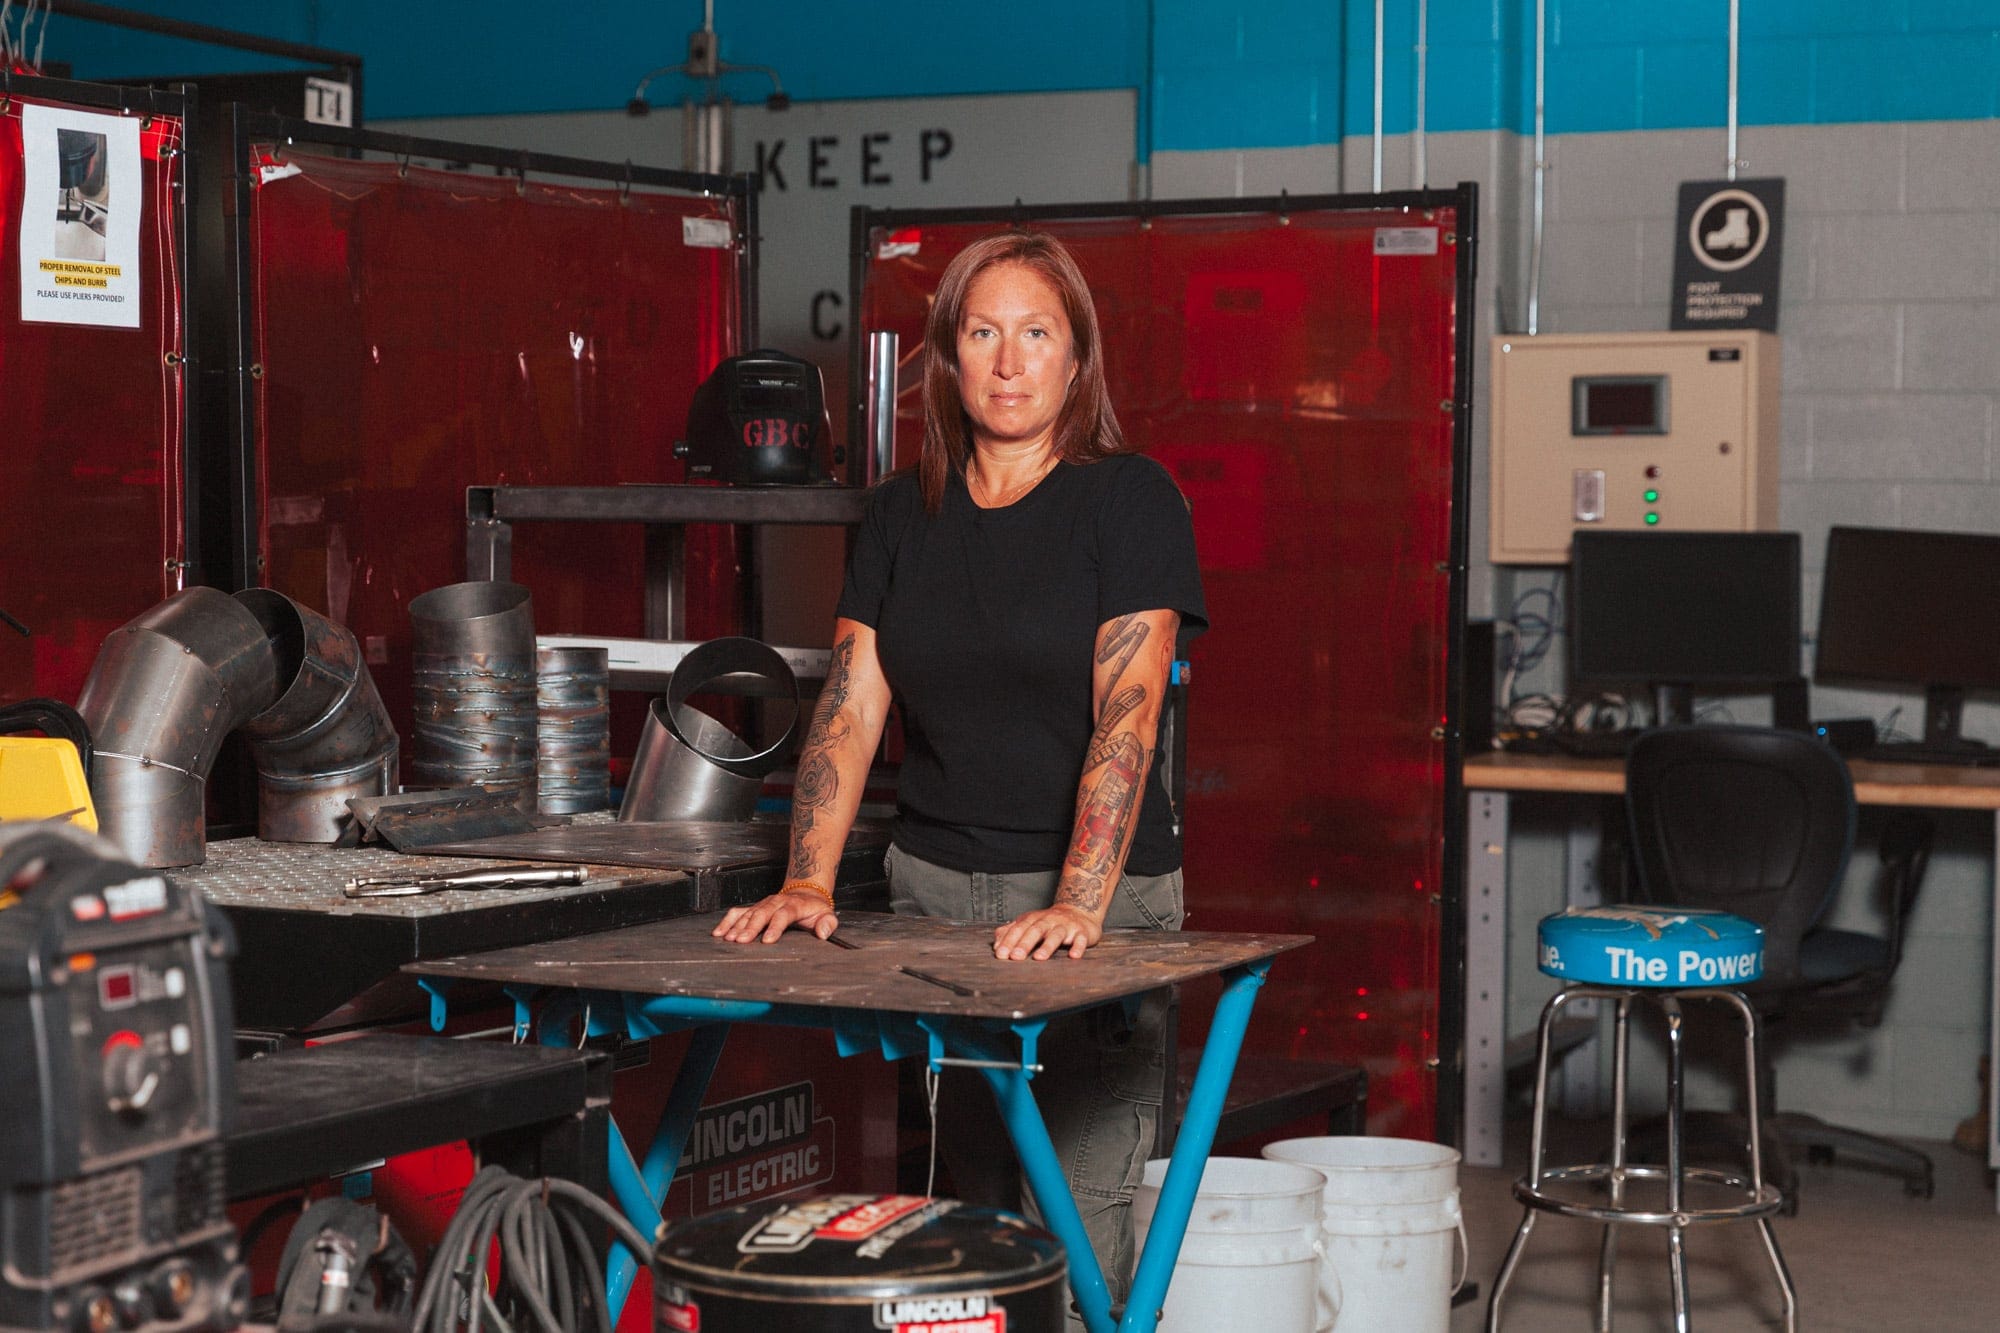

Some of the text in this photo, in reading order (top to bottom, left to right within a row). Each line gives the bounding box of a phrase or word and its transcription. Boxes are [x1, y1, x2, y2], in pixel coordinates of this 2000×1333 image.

[755, 128, 954, 193] KEEP
[39, 262, 121, 276] PROPER REMOVAL OF STEEL
[54, 276, 107, 288] CHIPS AND BURRS
[37, 289, 125, 303] PLEASE USE PLIERS PROVIDED!
[1686, 293, 1763, 306] PROTECTION
[1685, 306, 1748, 320] REQUIRED
[743, 418, 810, 449] GBC
[1605, 946, 1668, 982] The
[1678, 950, 1757, 982] Power
[708, 1144, 820, 1206] ELECTRIC
[882, 1296, 987, 1324] LINCOLN
